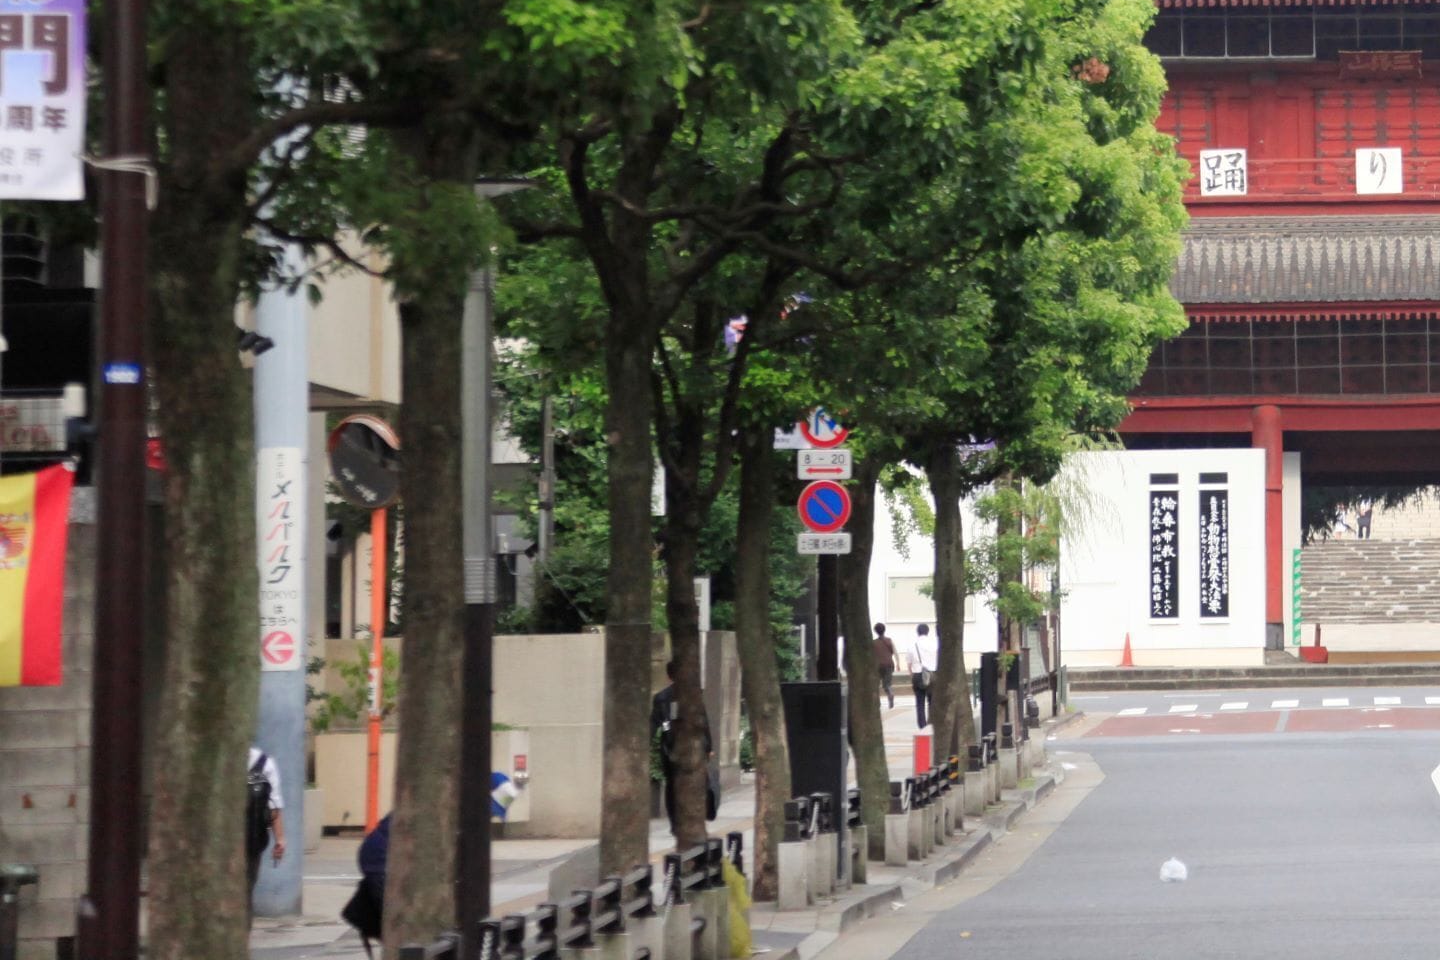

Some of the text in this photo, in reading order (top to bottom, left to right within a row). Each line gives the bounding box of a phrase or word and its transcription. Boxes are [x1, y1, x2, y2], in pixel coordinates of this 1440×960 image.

[0, 105, 67, 133] 周年
[1204, 152, 1245, 192] 踊
[1369, 151, 1388, 189] り
[265, 480, 295, 584] メルパルク
